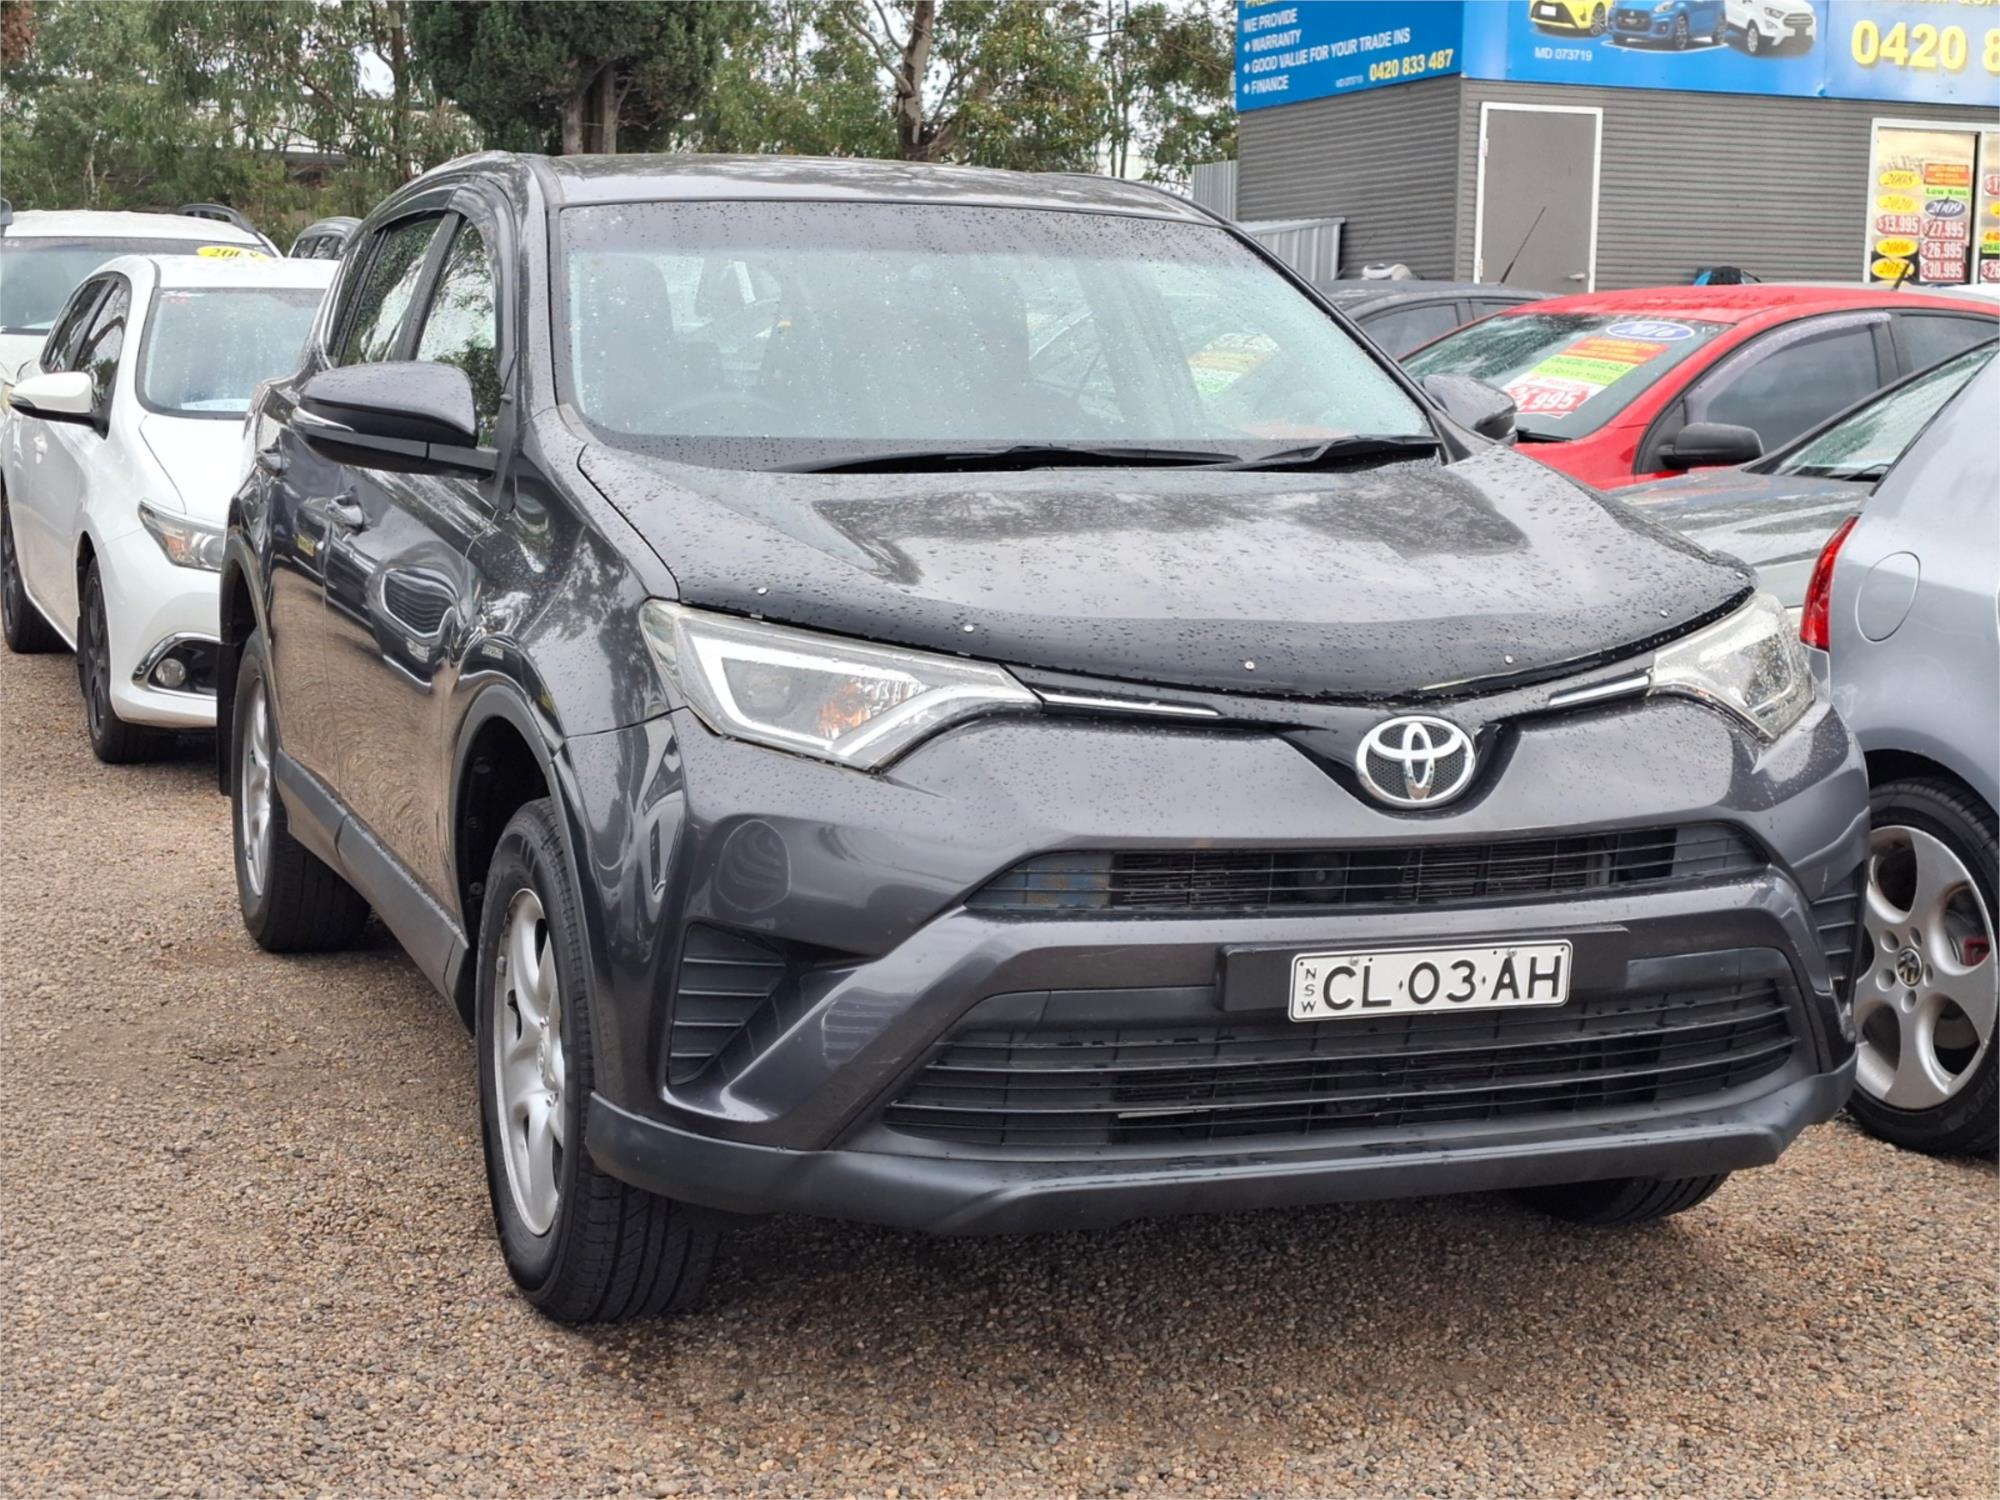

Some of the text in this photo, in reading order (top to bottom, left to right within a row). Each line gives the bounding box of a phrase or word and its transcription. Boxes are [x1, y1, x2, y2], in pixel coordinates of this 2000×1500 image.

[1244, 8, 1298, 33] WE PROVIDE
[1251, 27, 1411, 73] GOOD VALUE FOR YOUR TRADE INS
[1252, 29, 1302, 52] WARRANTY
[1535, 47, 1593, 62] MD 073719
[1851, 20, 1967, 70] 0420
[1369, 48, 1454, 81] 0420 833 487
[1251, 75, 1289, 94] FINANCE
[1322, 964, 1392, 1011] CL
[1490, 954, 1563, 1001] AH
